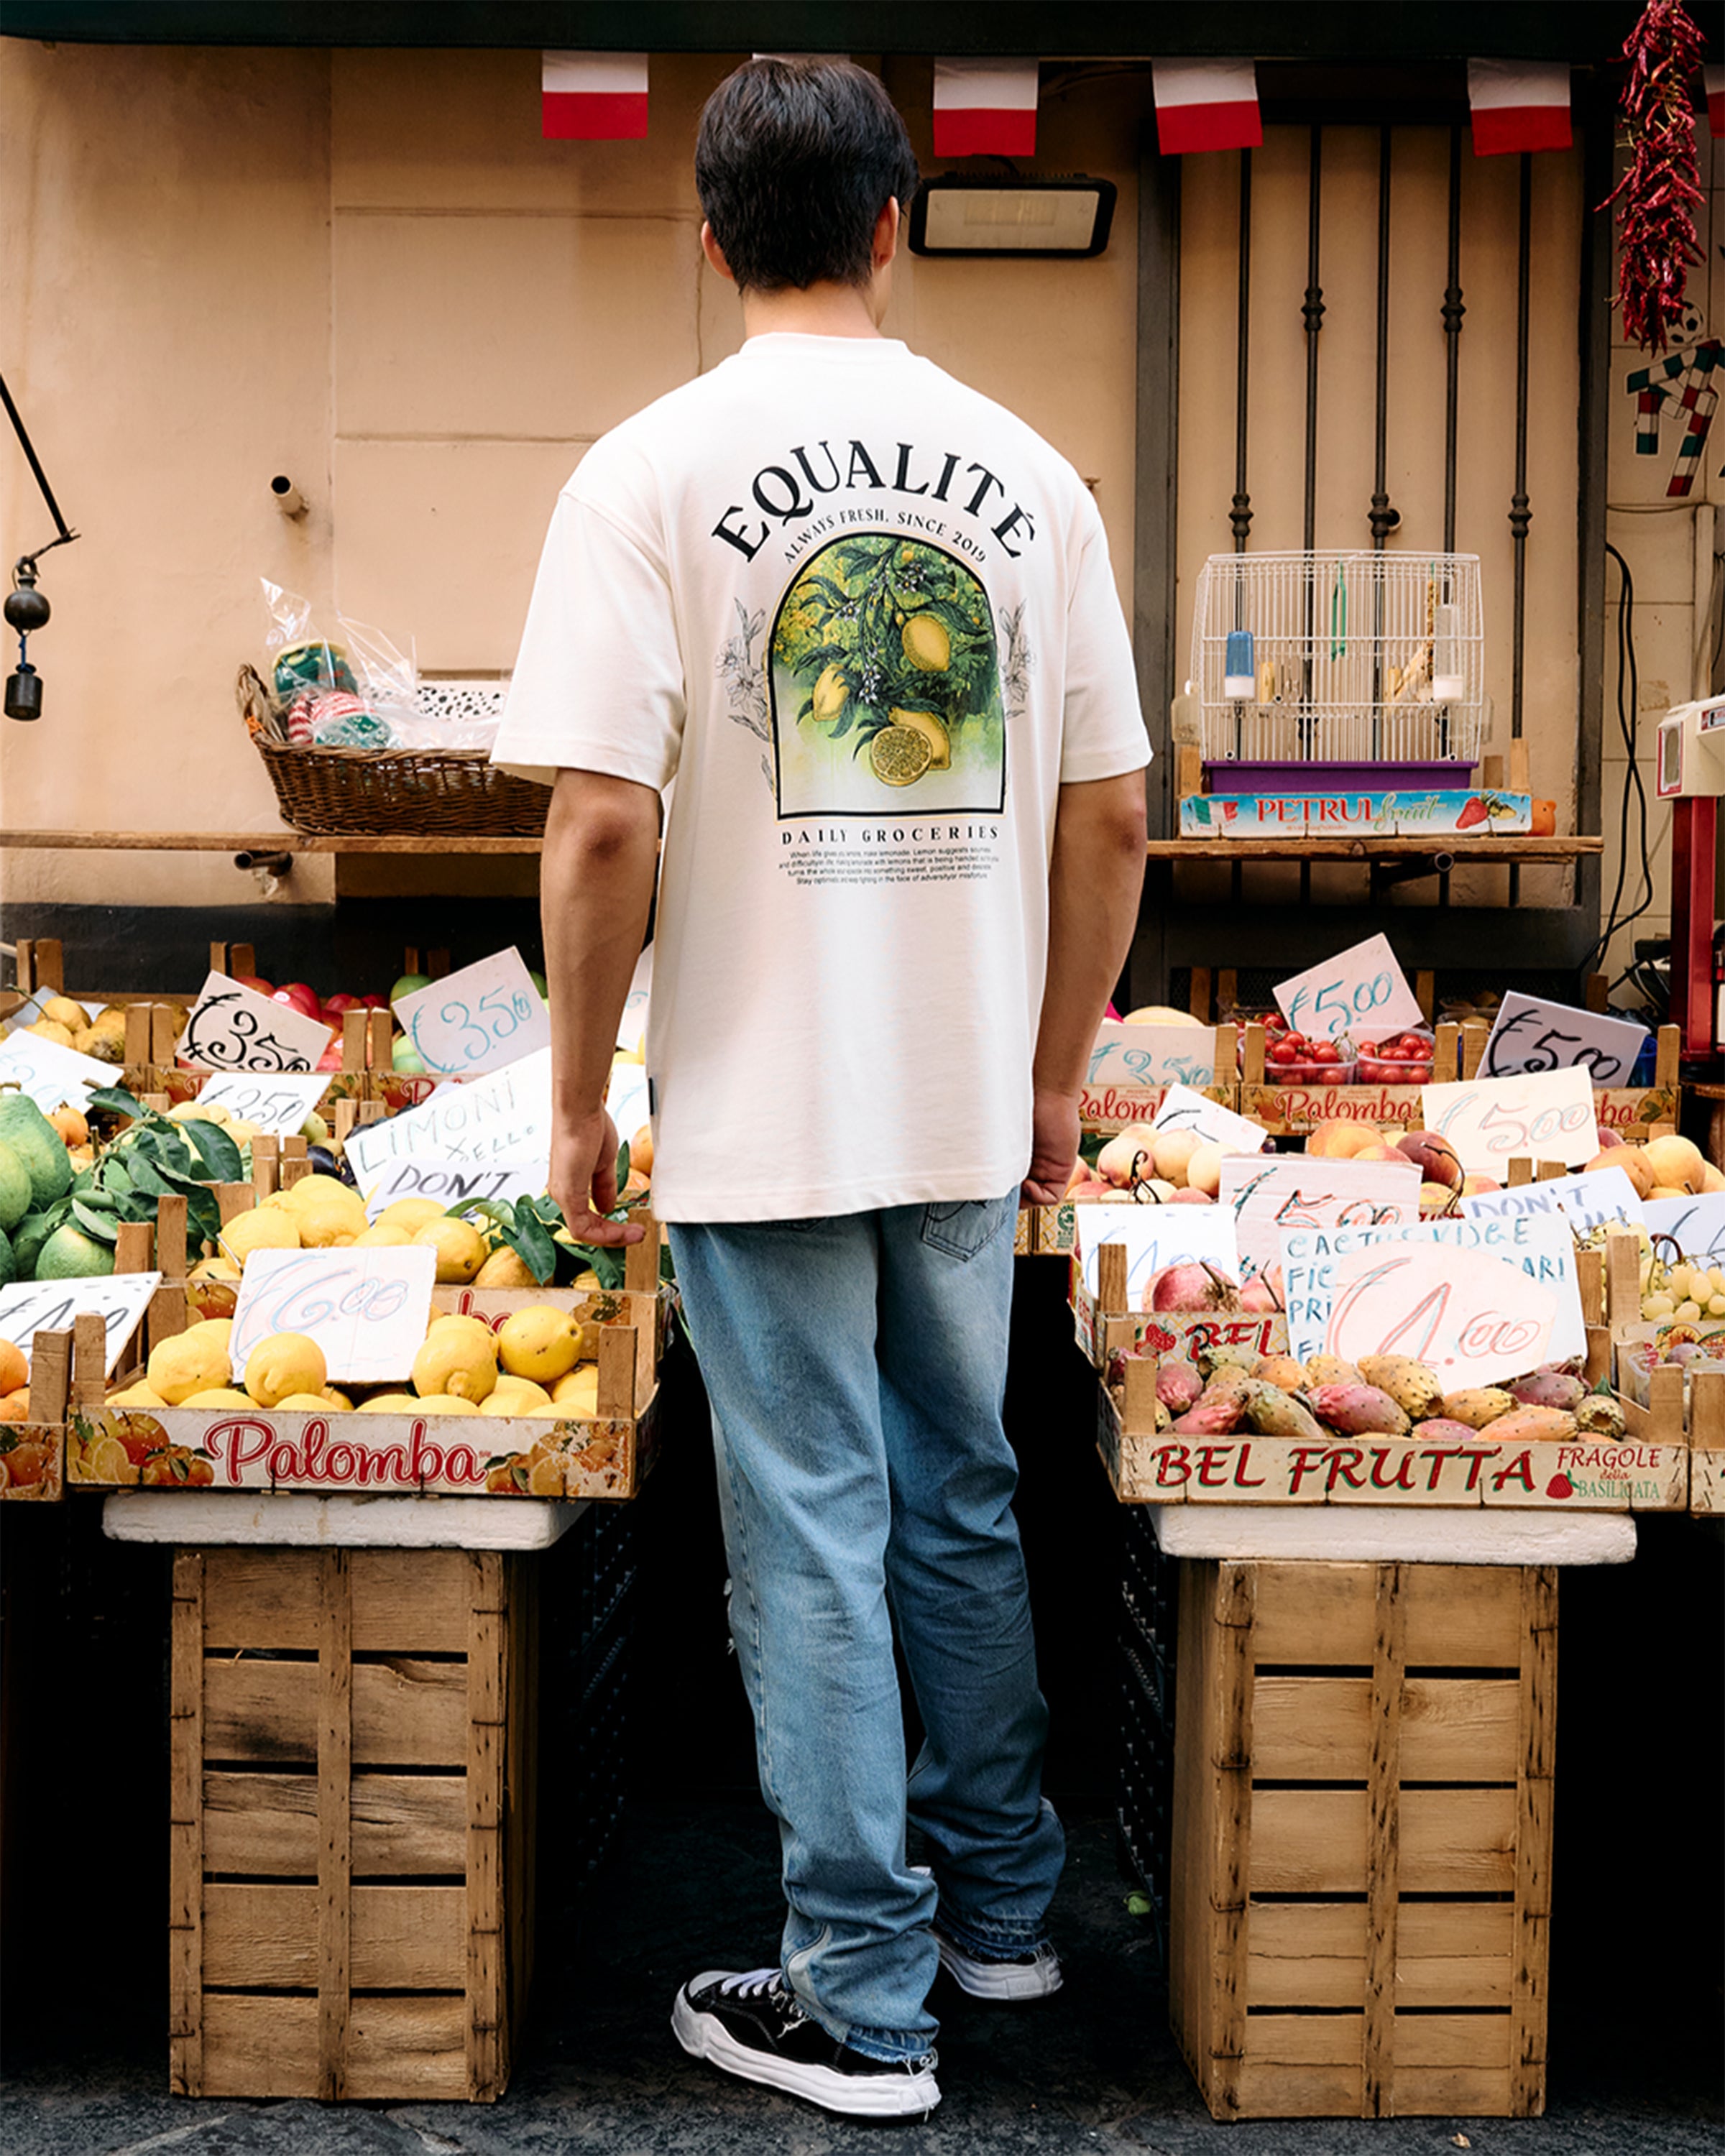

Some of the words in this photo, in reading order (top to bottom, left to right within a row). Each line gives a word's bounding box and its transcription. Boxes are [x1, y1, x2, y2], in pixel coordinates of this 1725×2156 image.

[711, 440, 1035, 563] EQUALITÉ
[783, 515, 835, 564] ALWAYS
[897, 510, 947, 537] SINCE
[952, 530, 987, 563] 2019
[1255, 798, 1384, 822] PETRUL
[782, 829, 847, 844] DAILY
[862, 826, 998, 843] GROCERIES
[1274, 1087, 1418, 1121] Palomba
[387, 1164, 520, 1199] DON'T
[204, 1416, 489, 1487] Palomba
[1557, 1446, 1662, 1470] FRAGOLE
[1150, 1442, 1266, 1488] BEL
[1287, 1445, 1536, 1496] FRUTTA
[1578, 1480, 1660, 1500] BASILICATA
